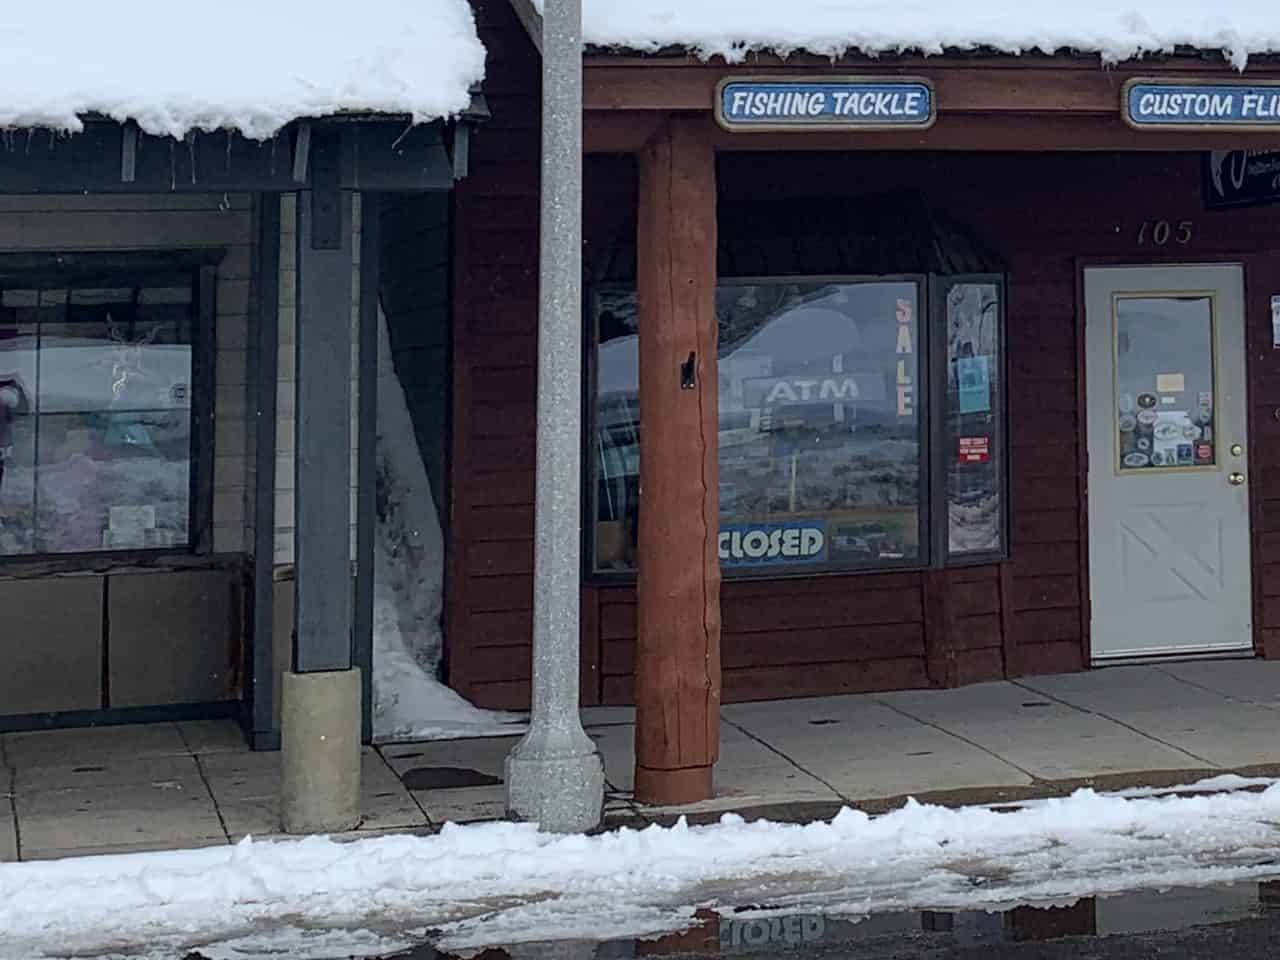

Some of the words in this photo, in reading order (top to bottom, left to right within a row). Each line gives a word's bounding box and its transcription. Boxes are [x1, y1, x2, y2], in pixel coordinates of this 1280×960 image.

[731, 91, 825, 116] FISHING
[831, 92, 921, 116] TACKLE
[1139, 93, 1233, 117] CUSTOM
[1138, 220, 1193, 246] 105
[896, 298, 913, 416] SALE
[767, 377, 860, 402] ATM
